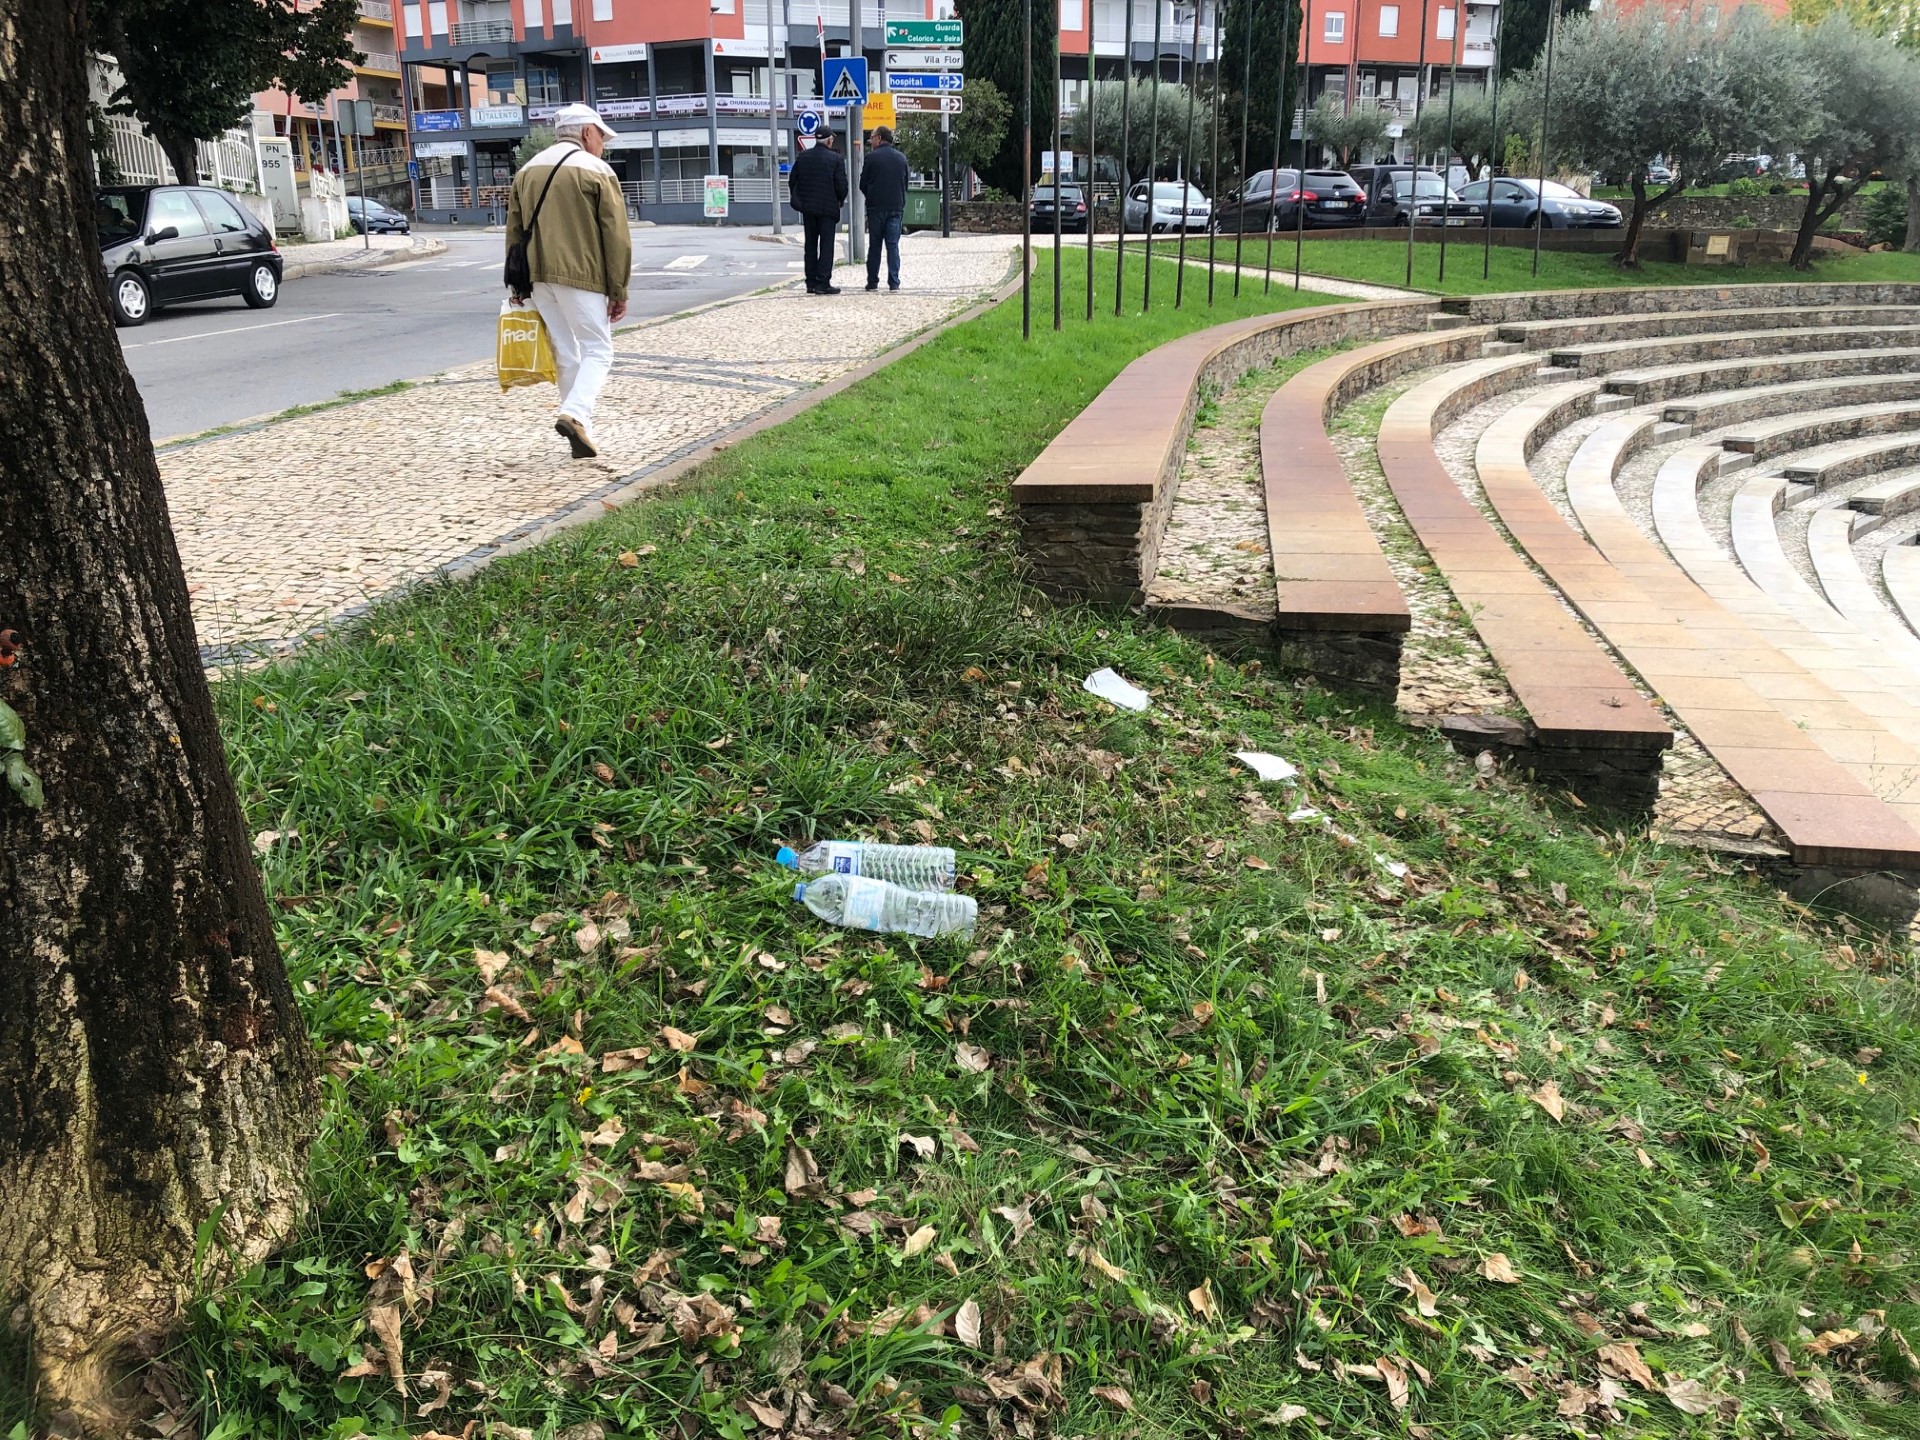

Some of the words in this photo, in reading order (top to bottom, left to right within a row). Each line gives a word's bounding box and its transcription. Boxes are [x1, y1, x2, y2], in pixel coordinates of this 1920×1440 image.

[924, 55, 940, 63] Vila
[944, 55, 960, 63] Flor
[890, 77, 923, 86] hospital
[485, 111, 518, 120] TALENTO
[266, 145, 279, 153] PN
[262, 160, 280, 168] 955
[502, 328, 537, 345] fnac
